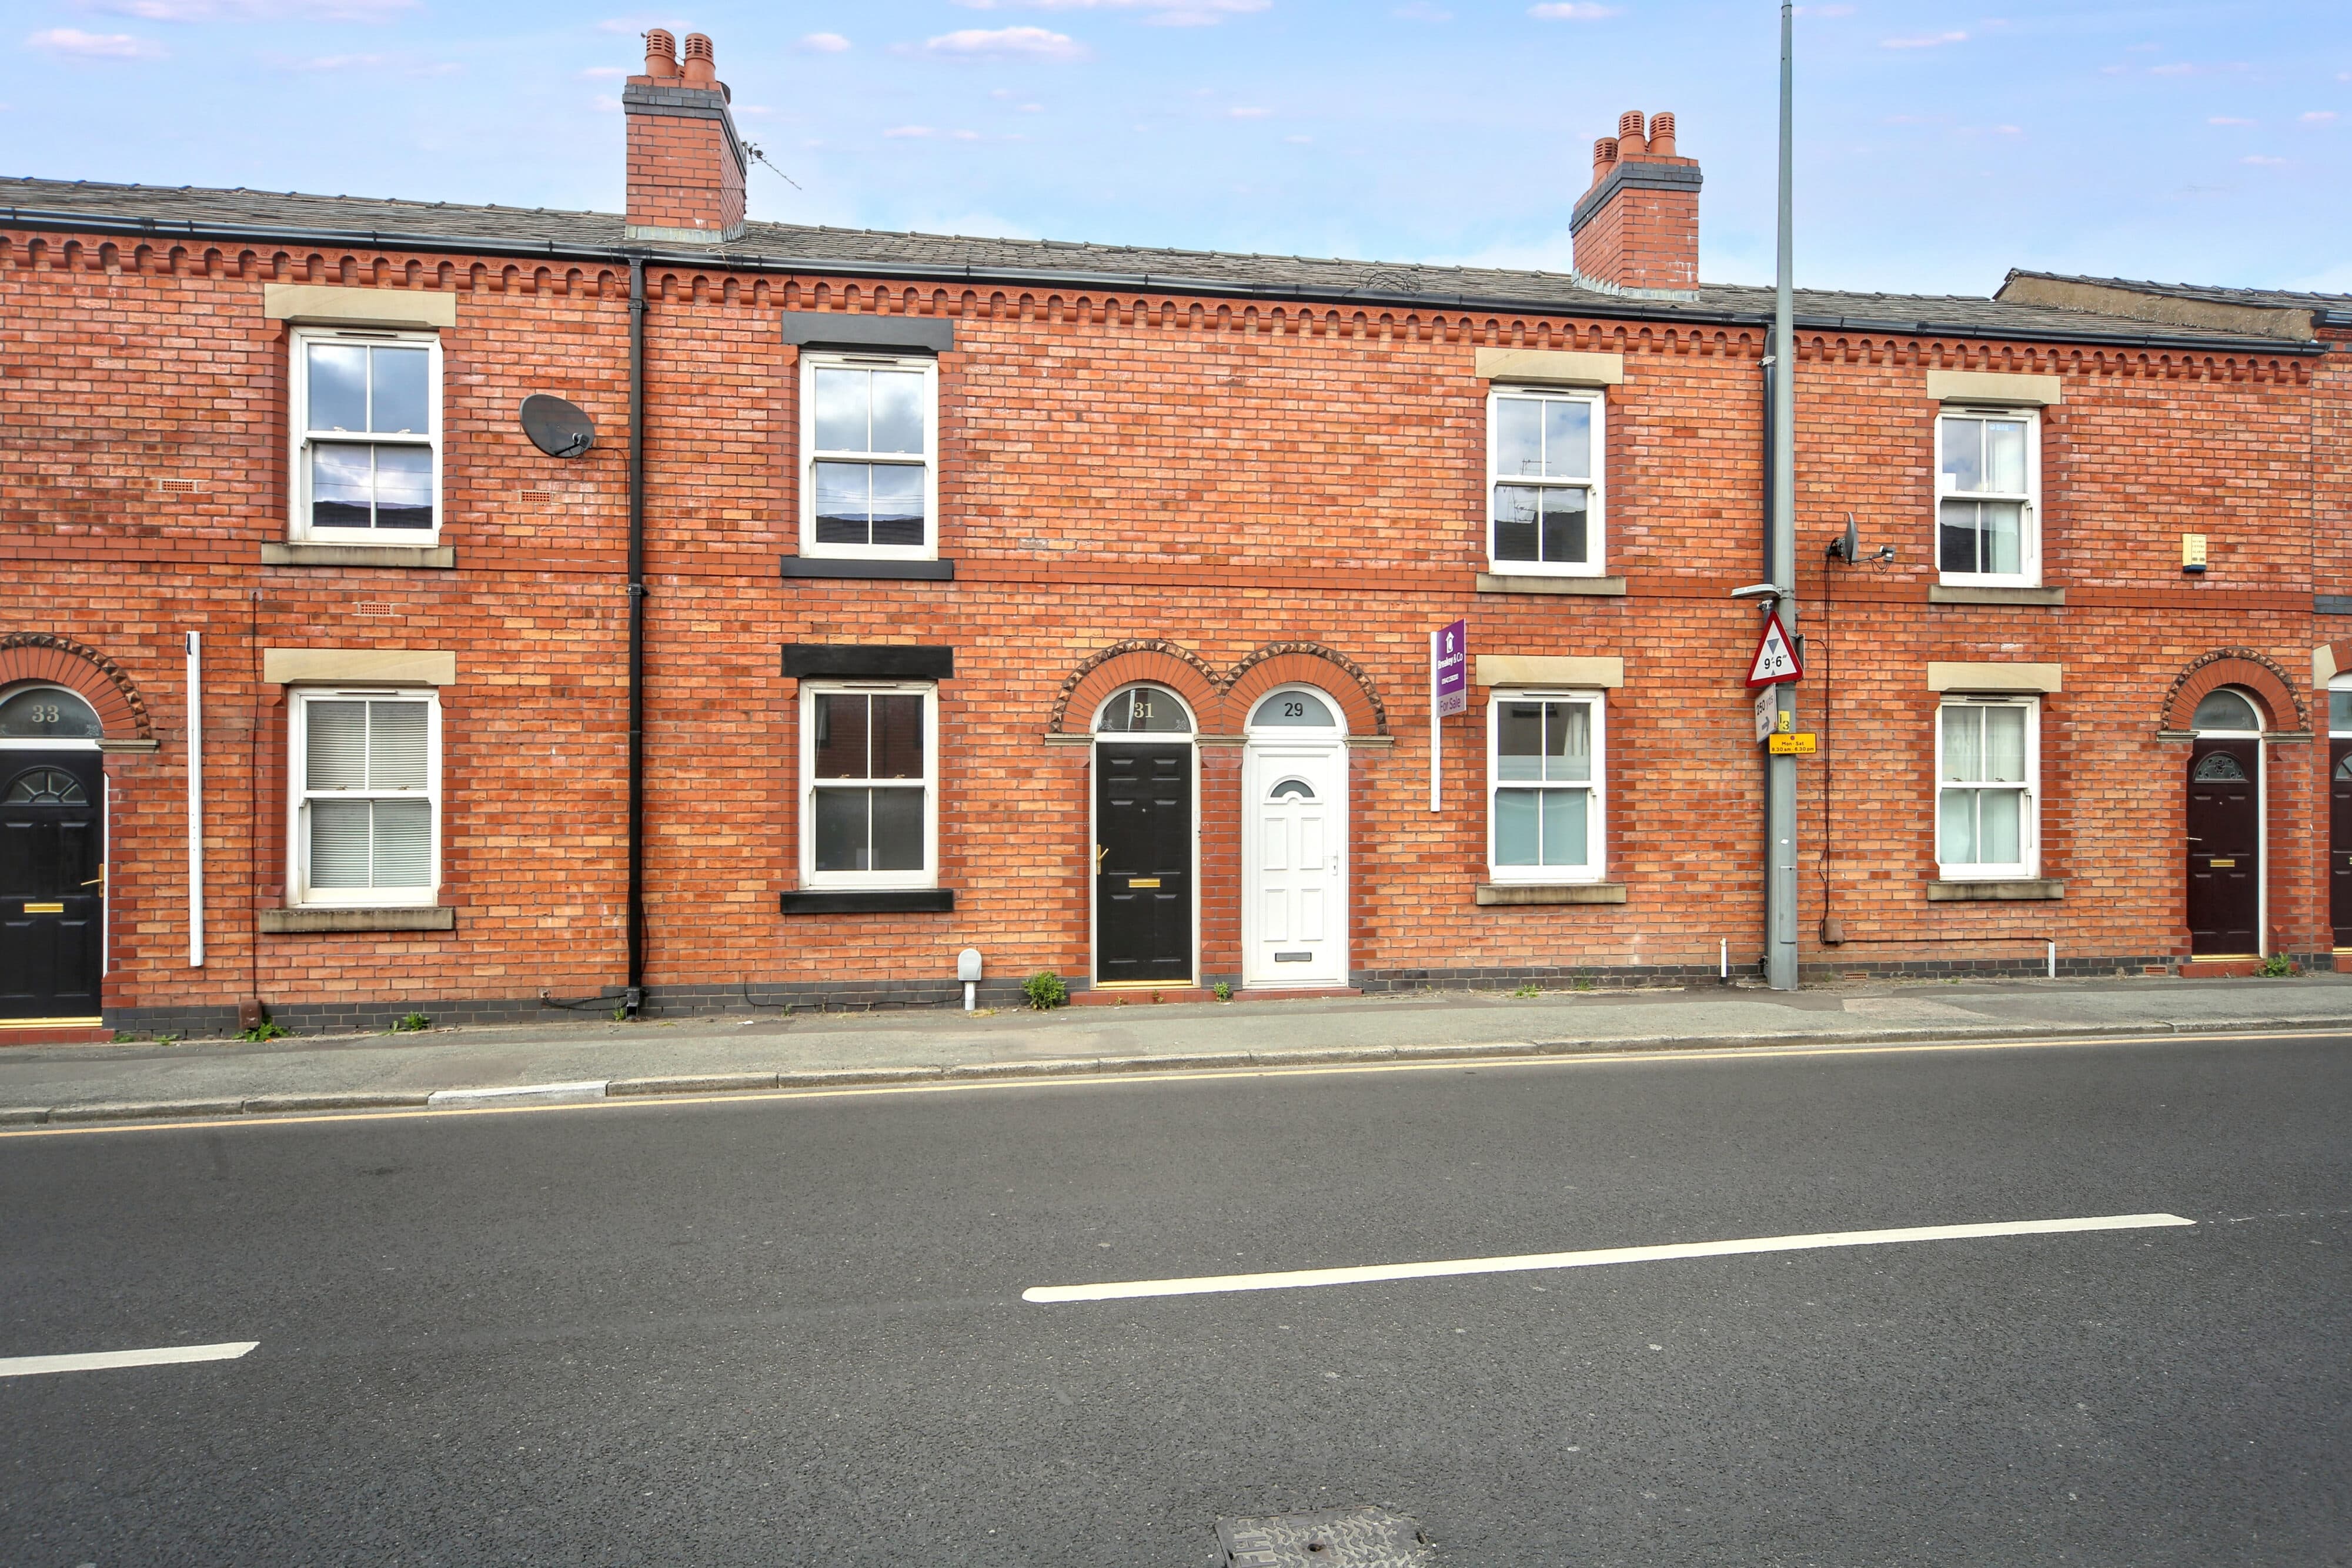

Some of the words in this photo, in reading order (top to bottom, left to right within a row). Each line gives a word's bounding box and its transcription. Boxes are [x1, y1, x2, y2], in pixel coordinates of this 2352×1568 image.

[1454, 653, 1456, 663] &
[1456, 652, 1463, 662] Co
[1134, 702, 1154, 718] 31
[1284, 703, 1303, 717] 29
[1439, 700, 1448, 712] For
[1449, 696, 1461, 709] Sale
[1756, 700, 1765, 716] 250
[32, 705, 59, 723] 33
